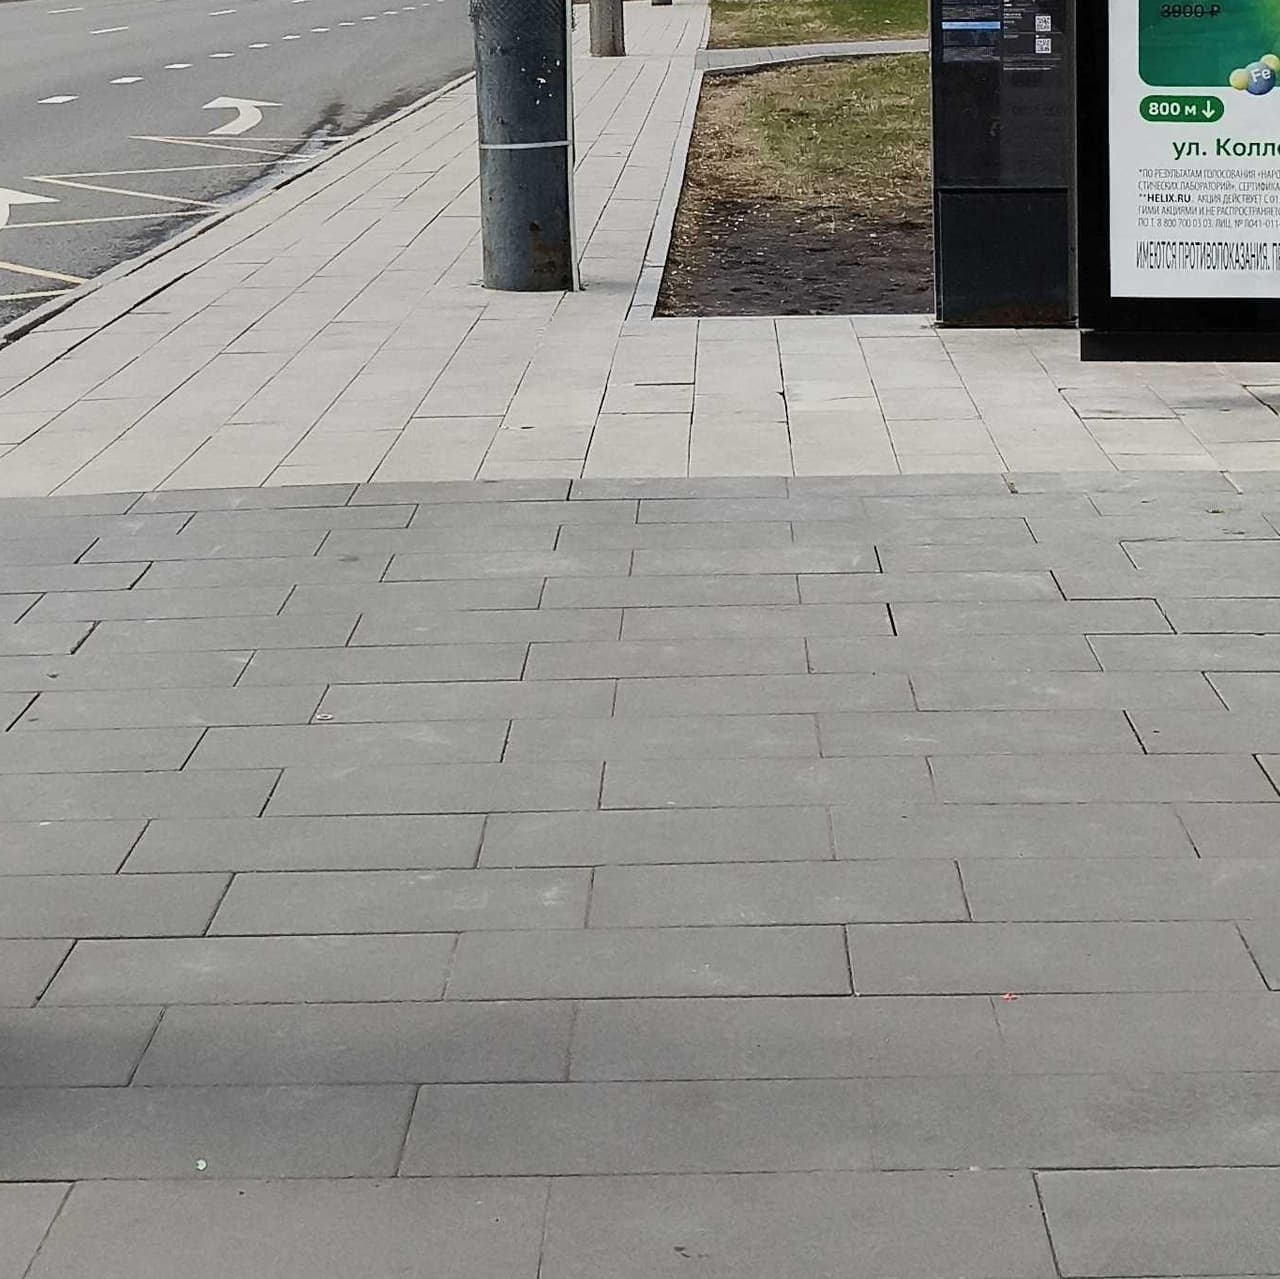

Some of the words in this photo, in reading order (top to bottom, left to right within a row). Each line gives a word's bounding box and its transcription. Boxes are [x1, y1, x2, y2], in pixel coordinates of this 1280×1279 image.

[1251, 67, 1272, 83] Fe
[1148, 102, 1181, 116] 800
[1185, 105, 1197, 116] м
[1172, 140, 1207, 160] ул.
[1197, 194, 1221, 203] АКЦИЯ
[1206, 206, 1216, 215] НЕ
[1136, 241, 1177, 269] ИМЕЮТСЯ
[1178, 241, 1270, 270] ПРОТИВОПОКАЗАНИЯ.
